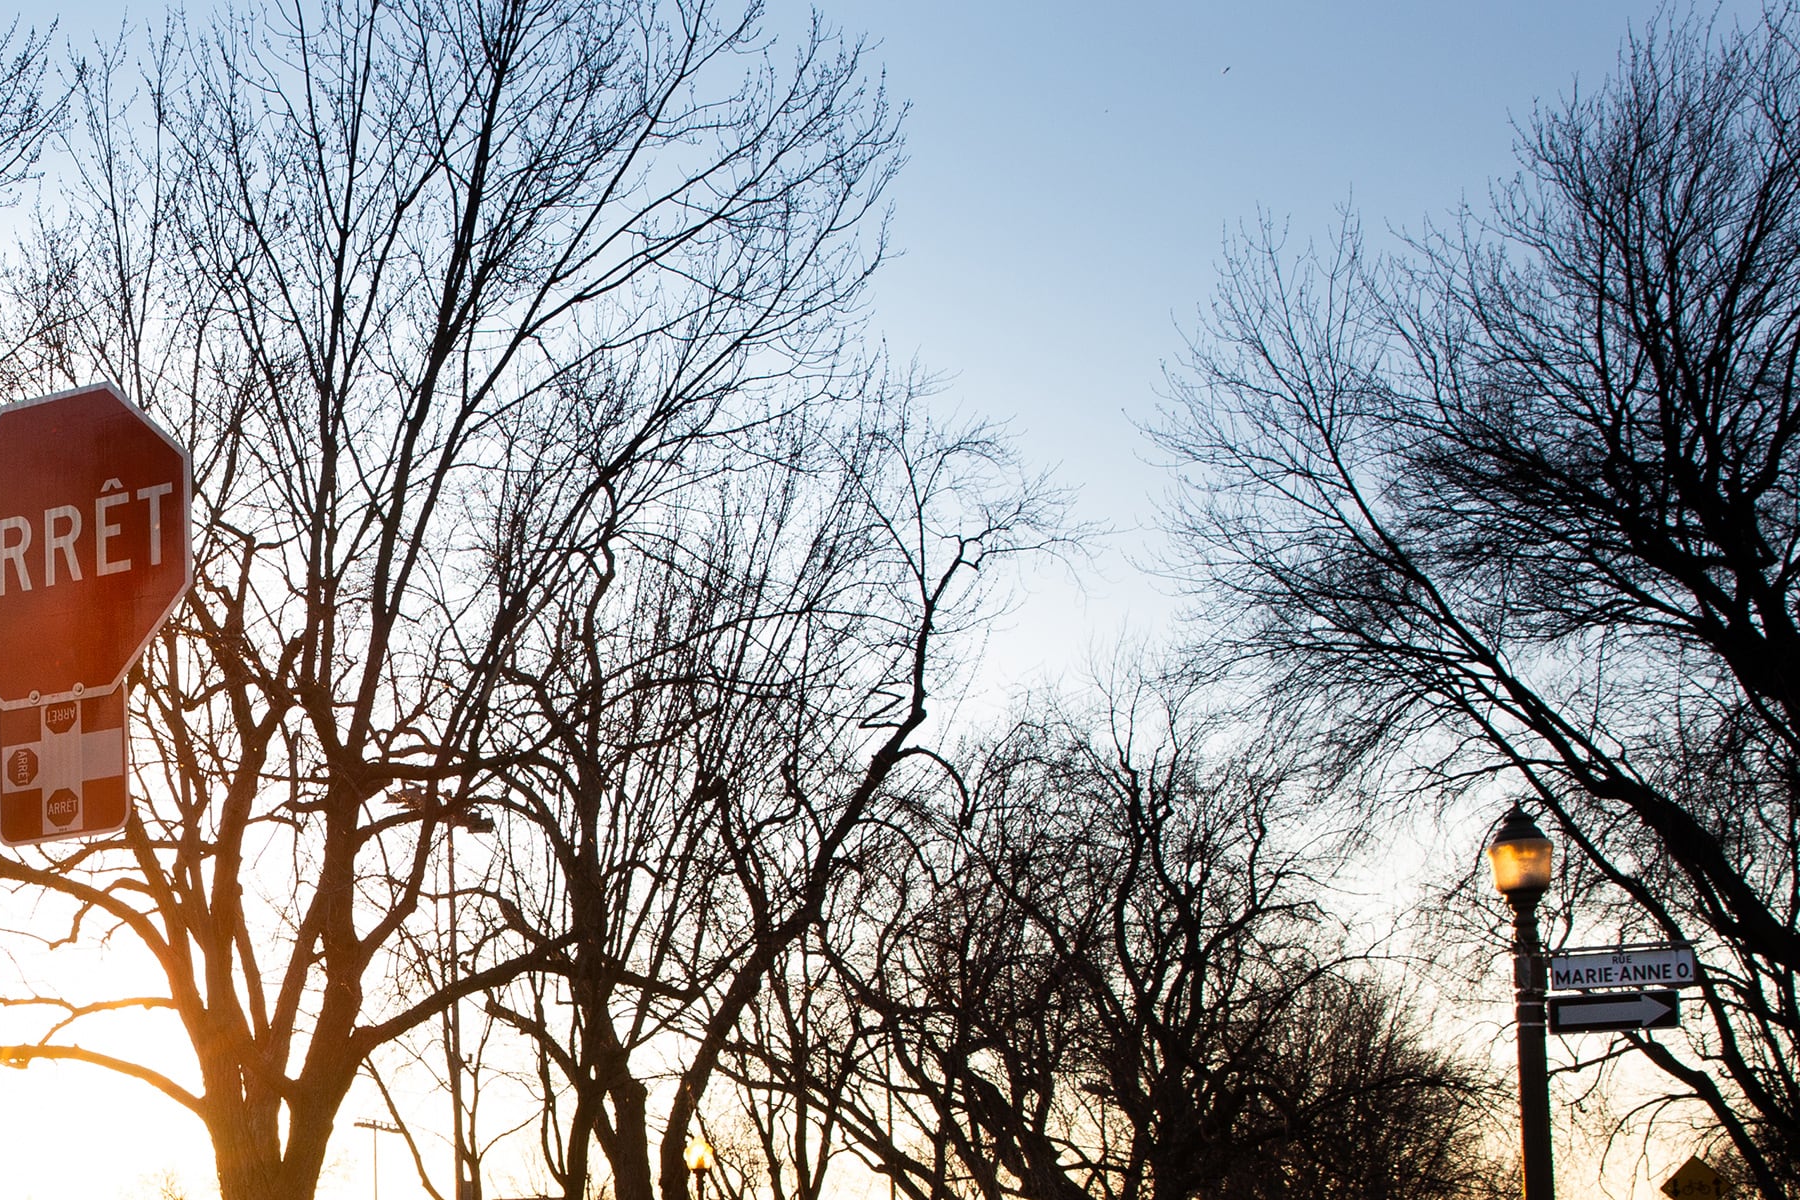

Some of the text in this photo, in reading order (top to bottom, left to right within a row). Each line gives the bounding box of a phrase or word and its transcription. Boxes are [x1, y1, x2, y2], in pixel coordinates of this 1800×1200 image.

[46, 705, 77, 725] ARRÊT
[17, 751, 29, 785] ARRÊT
[47, 798, 79, 816] ARRÊT
[1612, 955, 1632, 965] RUE
[1555, 963, 1693, 985] MARIE-ANNE O.
